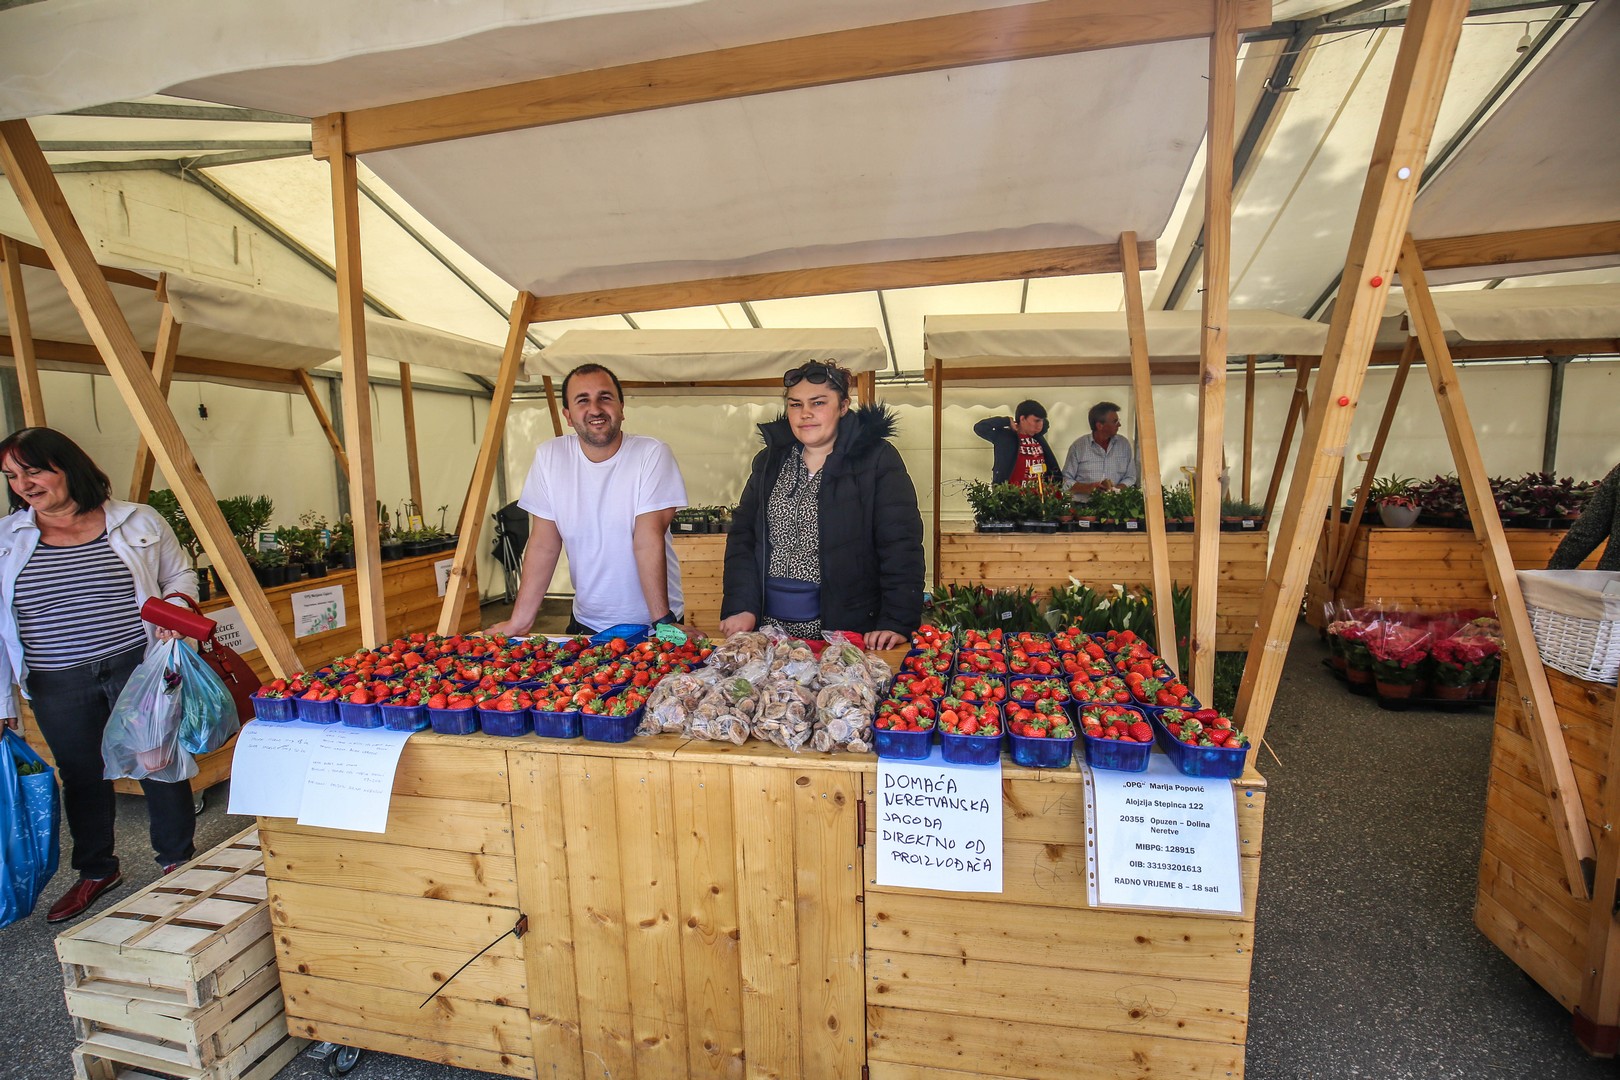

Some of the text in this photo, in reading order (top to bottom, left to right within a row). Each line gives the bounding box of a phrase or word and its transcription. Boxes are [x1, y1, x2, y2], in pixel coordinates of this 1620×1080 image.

[885, 773, 957, 794] DOMAĆA
[1150, 782, 1173, 791] Marija
[1175, 784, 1205, 792] Popović
[884, 792, 989, 813] NERETVANSKA
[1125, 798, 1204, 810] Alojzija Stepinca 122
[883, 812, 942, 830] JAGODA
[1120, 815, 1145, 823] 20355
[1150, 817, 1177, 826] Opuzen
[1186, 820, 1210, 828] Dolina
[1150, 827, 1179, 835] Neretve
[882, 829, 986, 854] DIREKTNO OD
[1135, 843, 1195, 854] MIBPG: 128915
[891, 851, 992, 872] PROIZVOĐAČA
[1129, 860, 1202, 873] OIB: 33193201613
[1114, 877, 1141, 886] RADNO
[1143, 879, 1176, 889] VRIJEME
